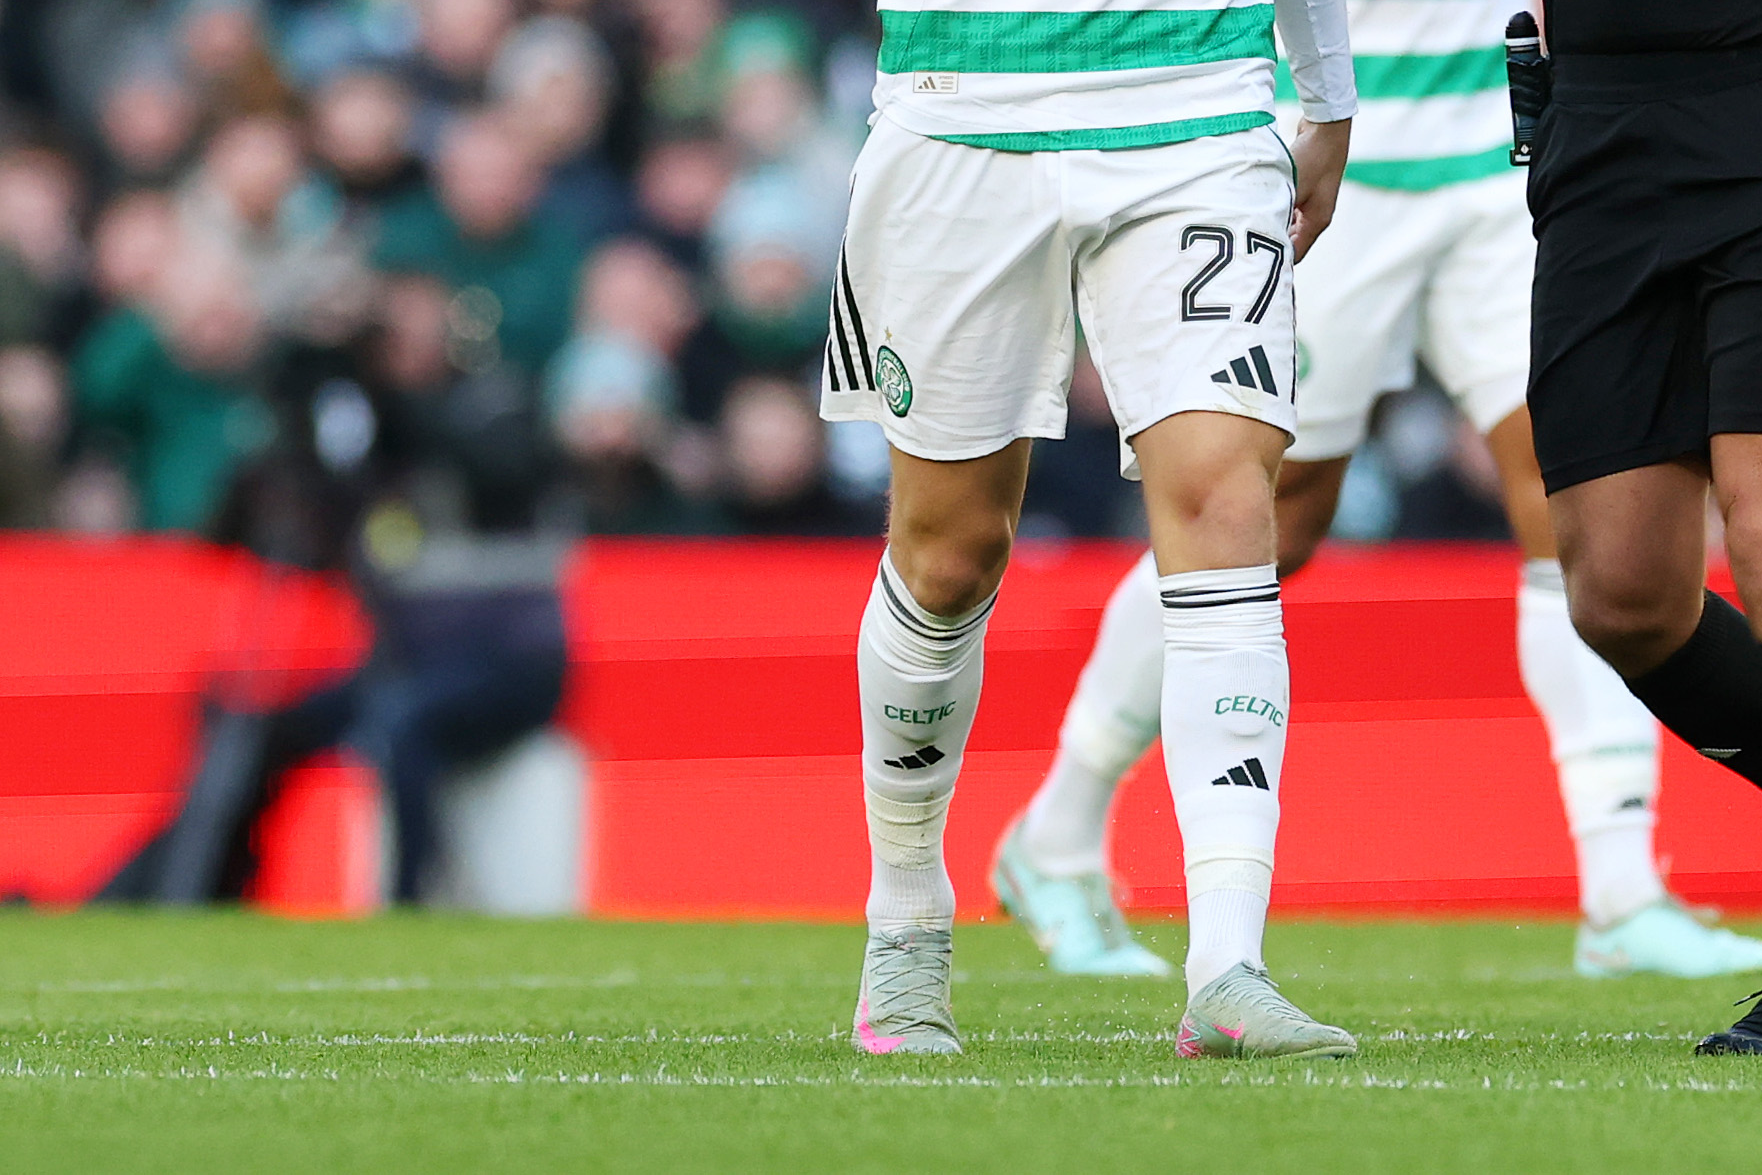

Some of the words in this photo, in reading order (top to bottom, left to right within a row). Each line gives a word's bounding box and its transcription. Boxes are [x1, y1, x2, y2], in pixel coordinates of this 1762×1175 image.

[1179, 224, 1285, 324] 27
[884, 700, 956, 724] CELTIC
[1214, 695, 1284, 727] CELTIC
